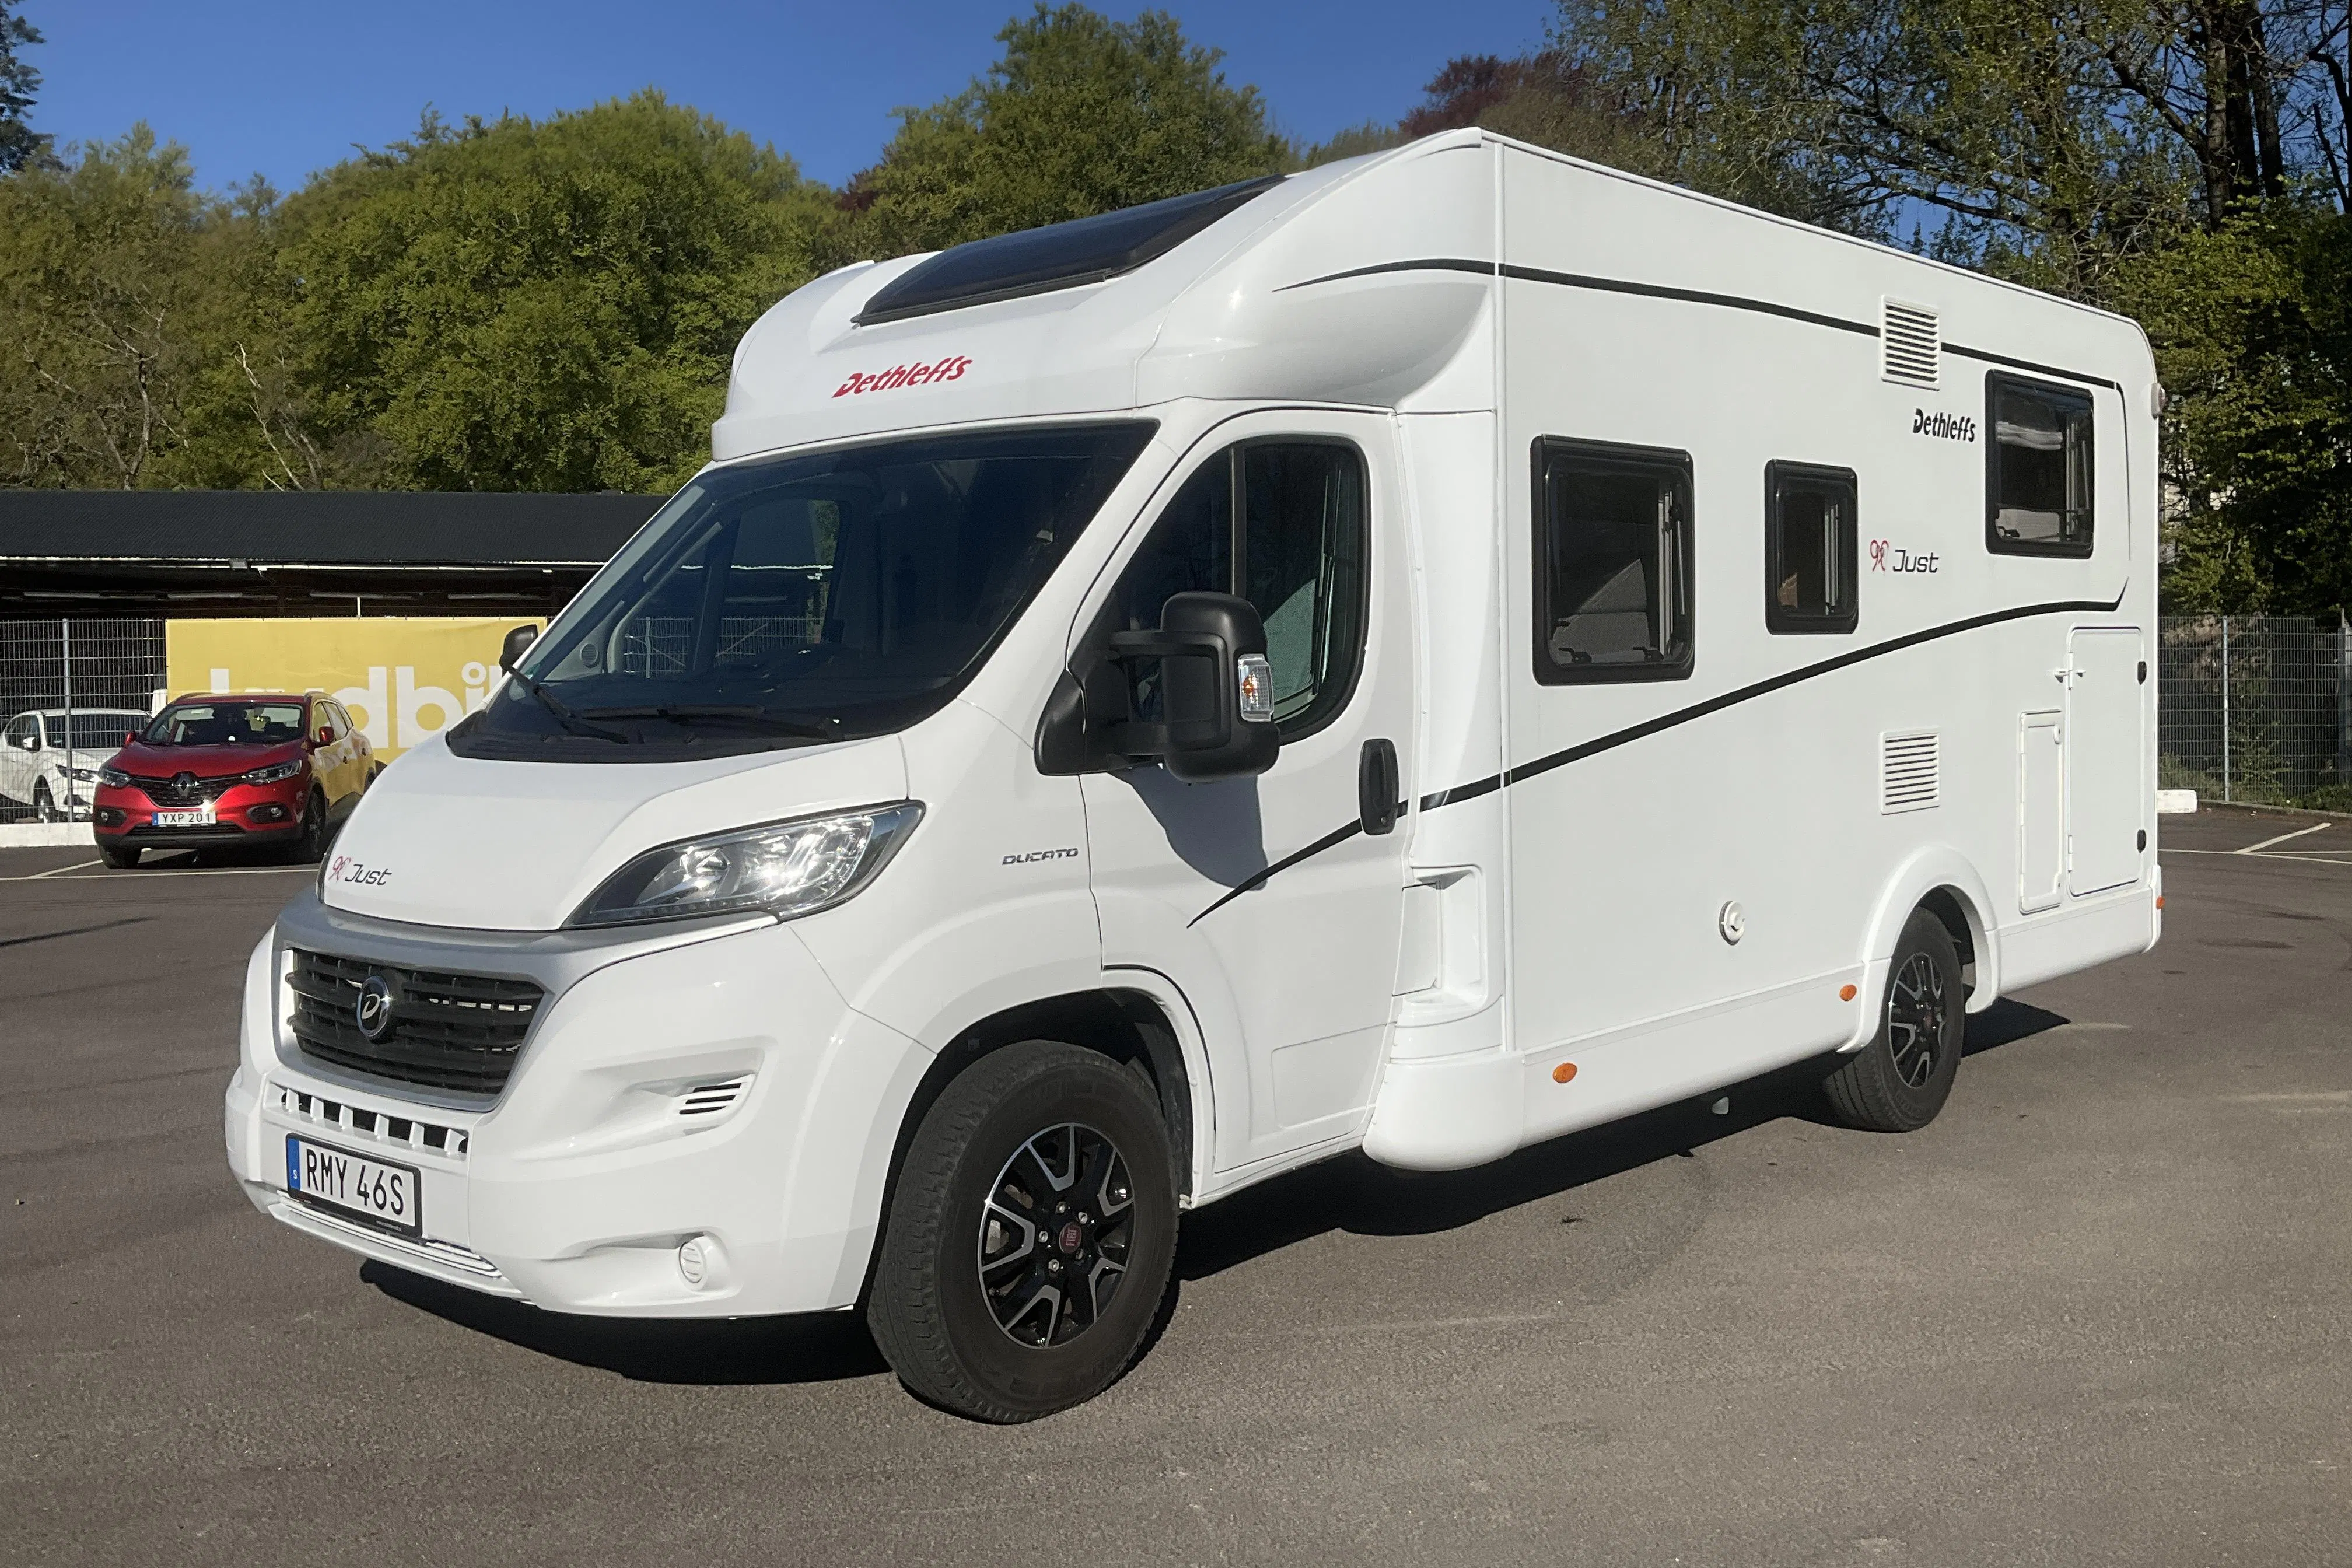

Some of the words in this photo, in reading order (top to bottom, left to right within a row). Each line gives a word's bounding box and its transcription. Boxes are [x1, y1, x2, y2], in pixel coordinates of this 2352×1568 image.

[831, 355, 974, 398] Dethleffs
[1912, 408, 1976, 443] Dethleffs
[1892, 549, 1940, 573] Just
[162, 813, 184, 823] YXP
[188, 813, 211, 822] 201
[1002, 848, 1079, 866] DUCATO
[345, 864, 393, 886] Just
[292, 1168, 298, 1181] S
[306, 1147, 348, 1199] RMY
[356, 1164, 404, 1215] 46S
[1065, 1227, 1077, 1247] FIAT
